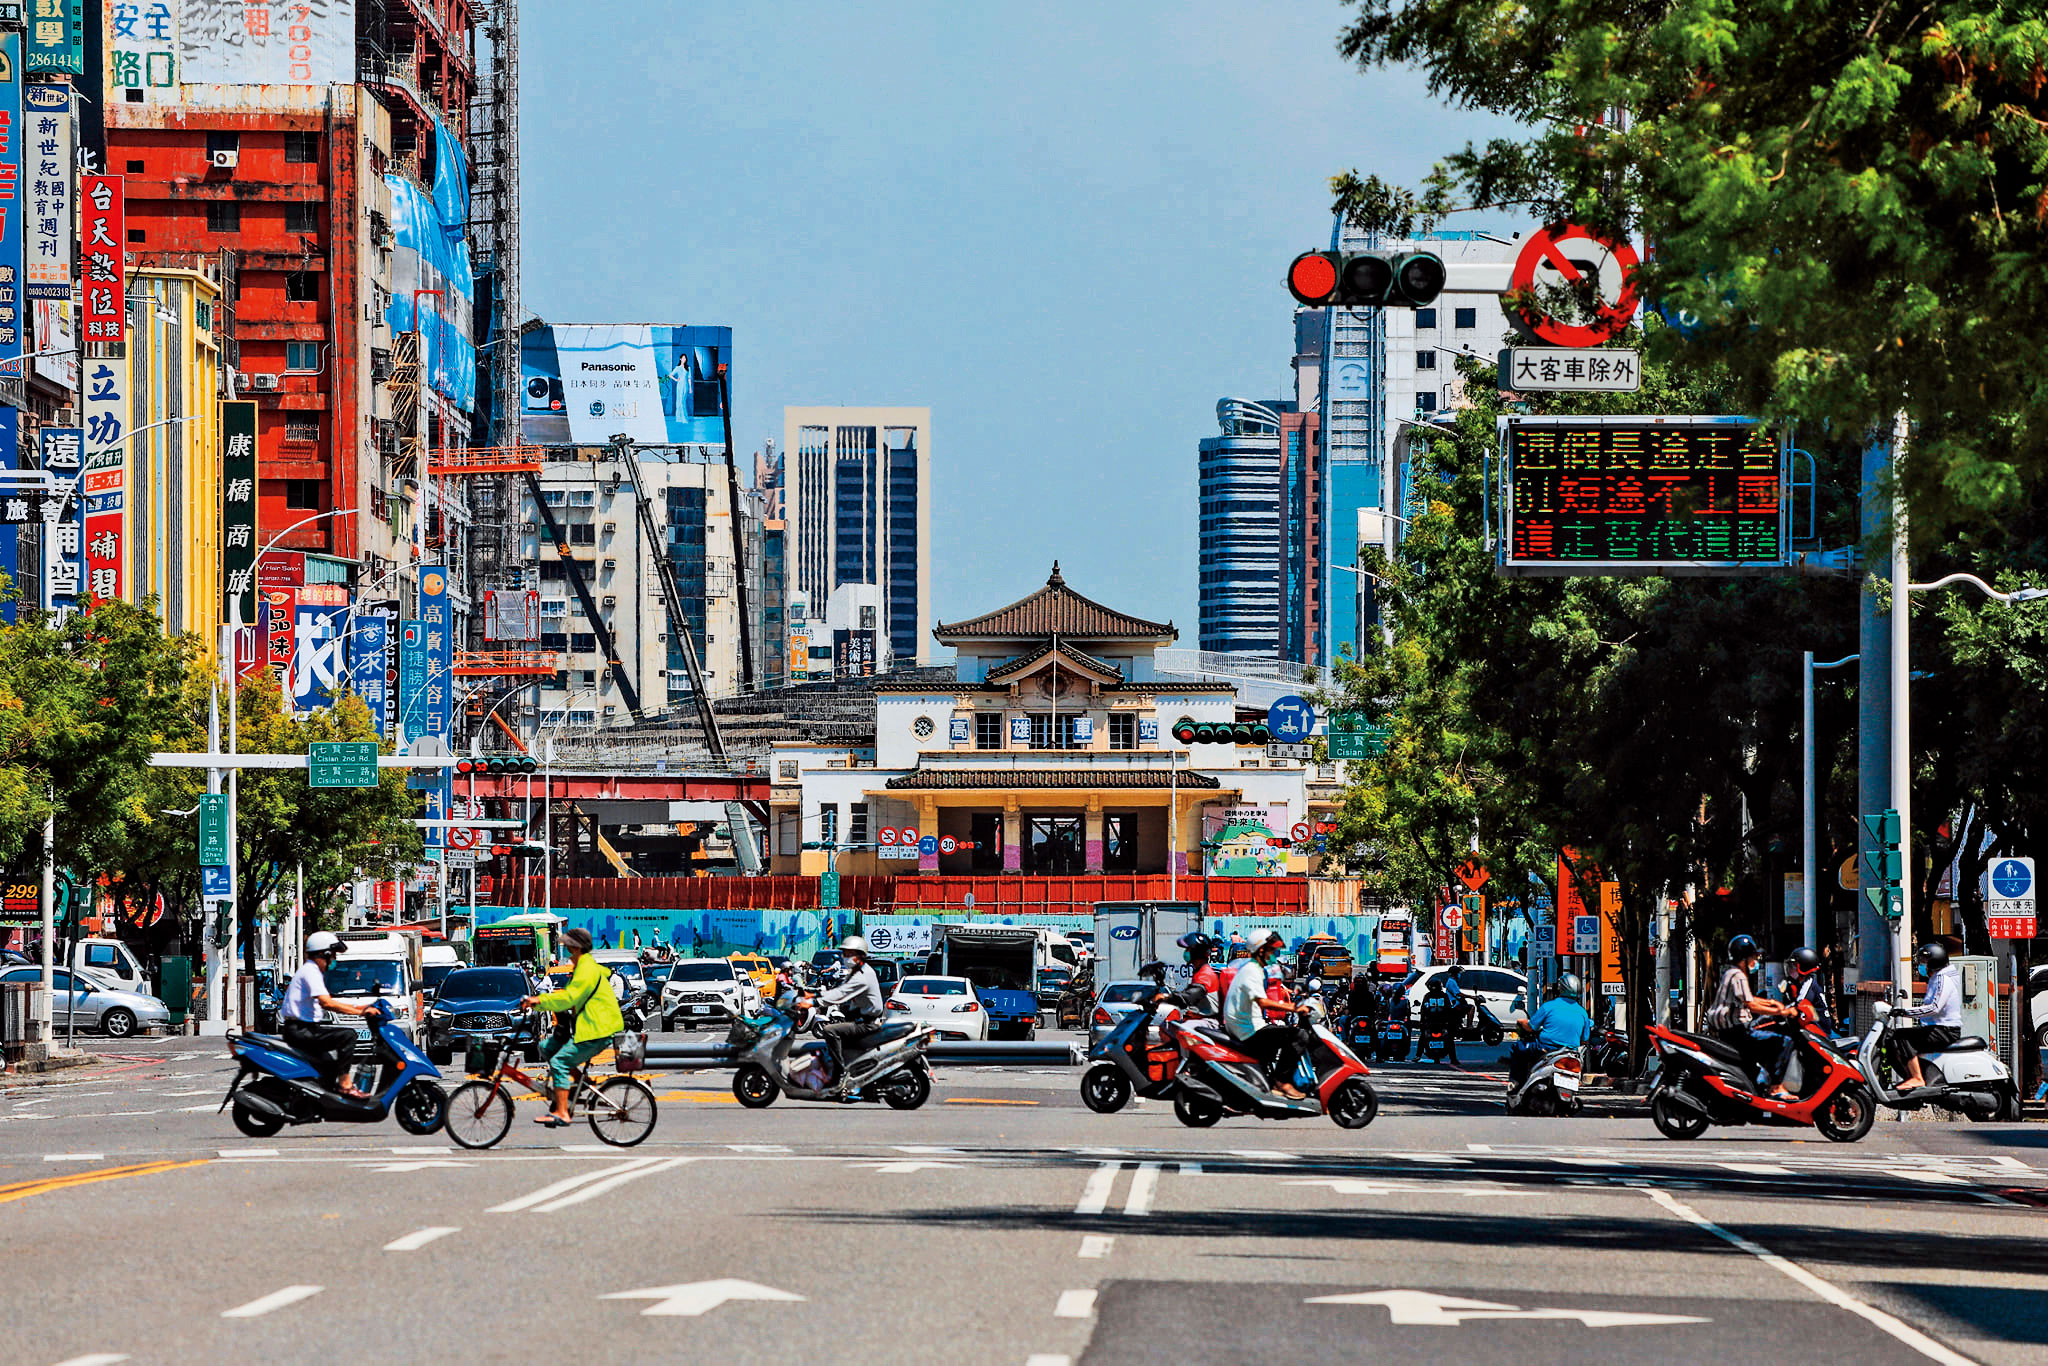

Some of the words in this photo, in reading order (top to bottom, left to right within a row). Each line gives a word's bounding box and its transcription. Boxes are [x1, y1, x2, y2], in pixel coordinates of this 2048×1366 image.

[114, 3, 171, 40] 安全
[28, 53, 81, 67] 2861414
[112, 50, 173, 87] 路口
[30, 87, 65, 103] 新世紀
[88, 321, 120, 337] 科技
[581, 362, 637, 371] Panasonic
[1517, 357, 1634, 382] 大客車除外
[88, 364, 122, 445] 立功
[226, 433, 252, 593] 康橋商旅
[90, 531, 119, 600] 補習
[951, 719, 1157, 739] 高雄車站
[317, 744, 370, 754] 七賢二路
[1336, 748, 1363, 756] Cisian
[317, 767, 370, 776] 七賢一路
[208, 804, 219, 845] 中山一路
[942, 841, 954, 850] 30
[5, 885, 38, 899] 299
[1991, 901, 2033, 910] 行人優先
